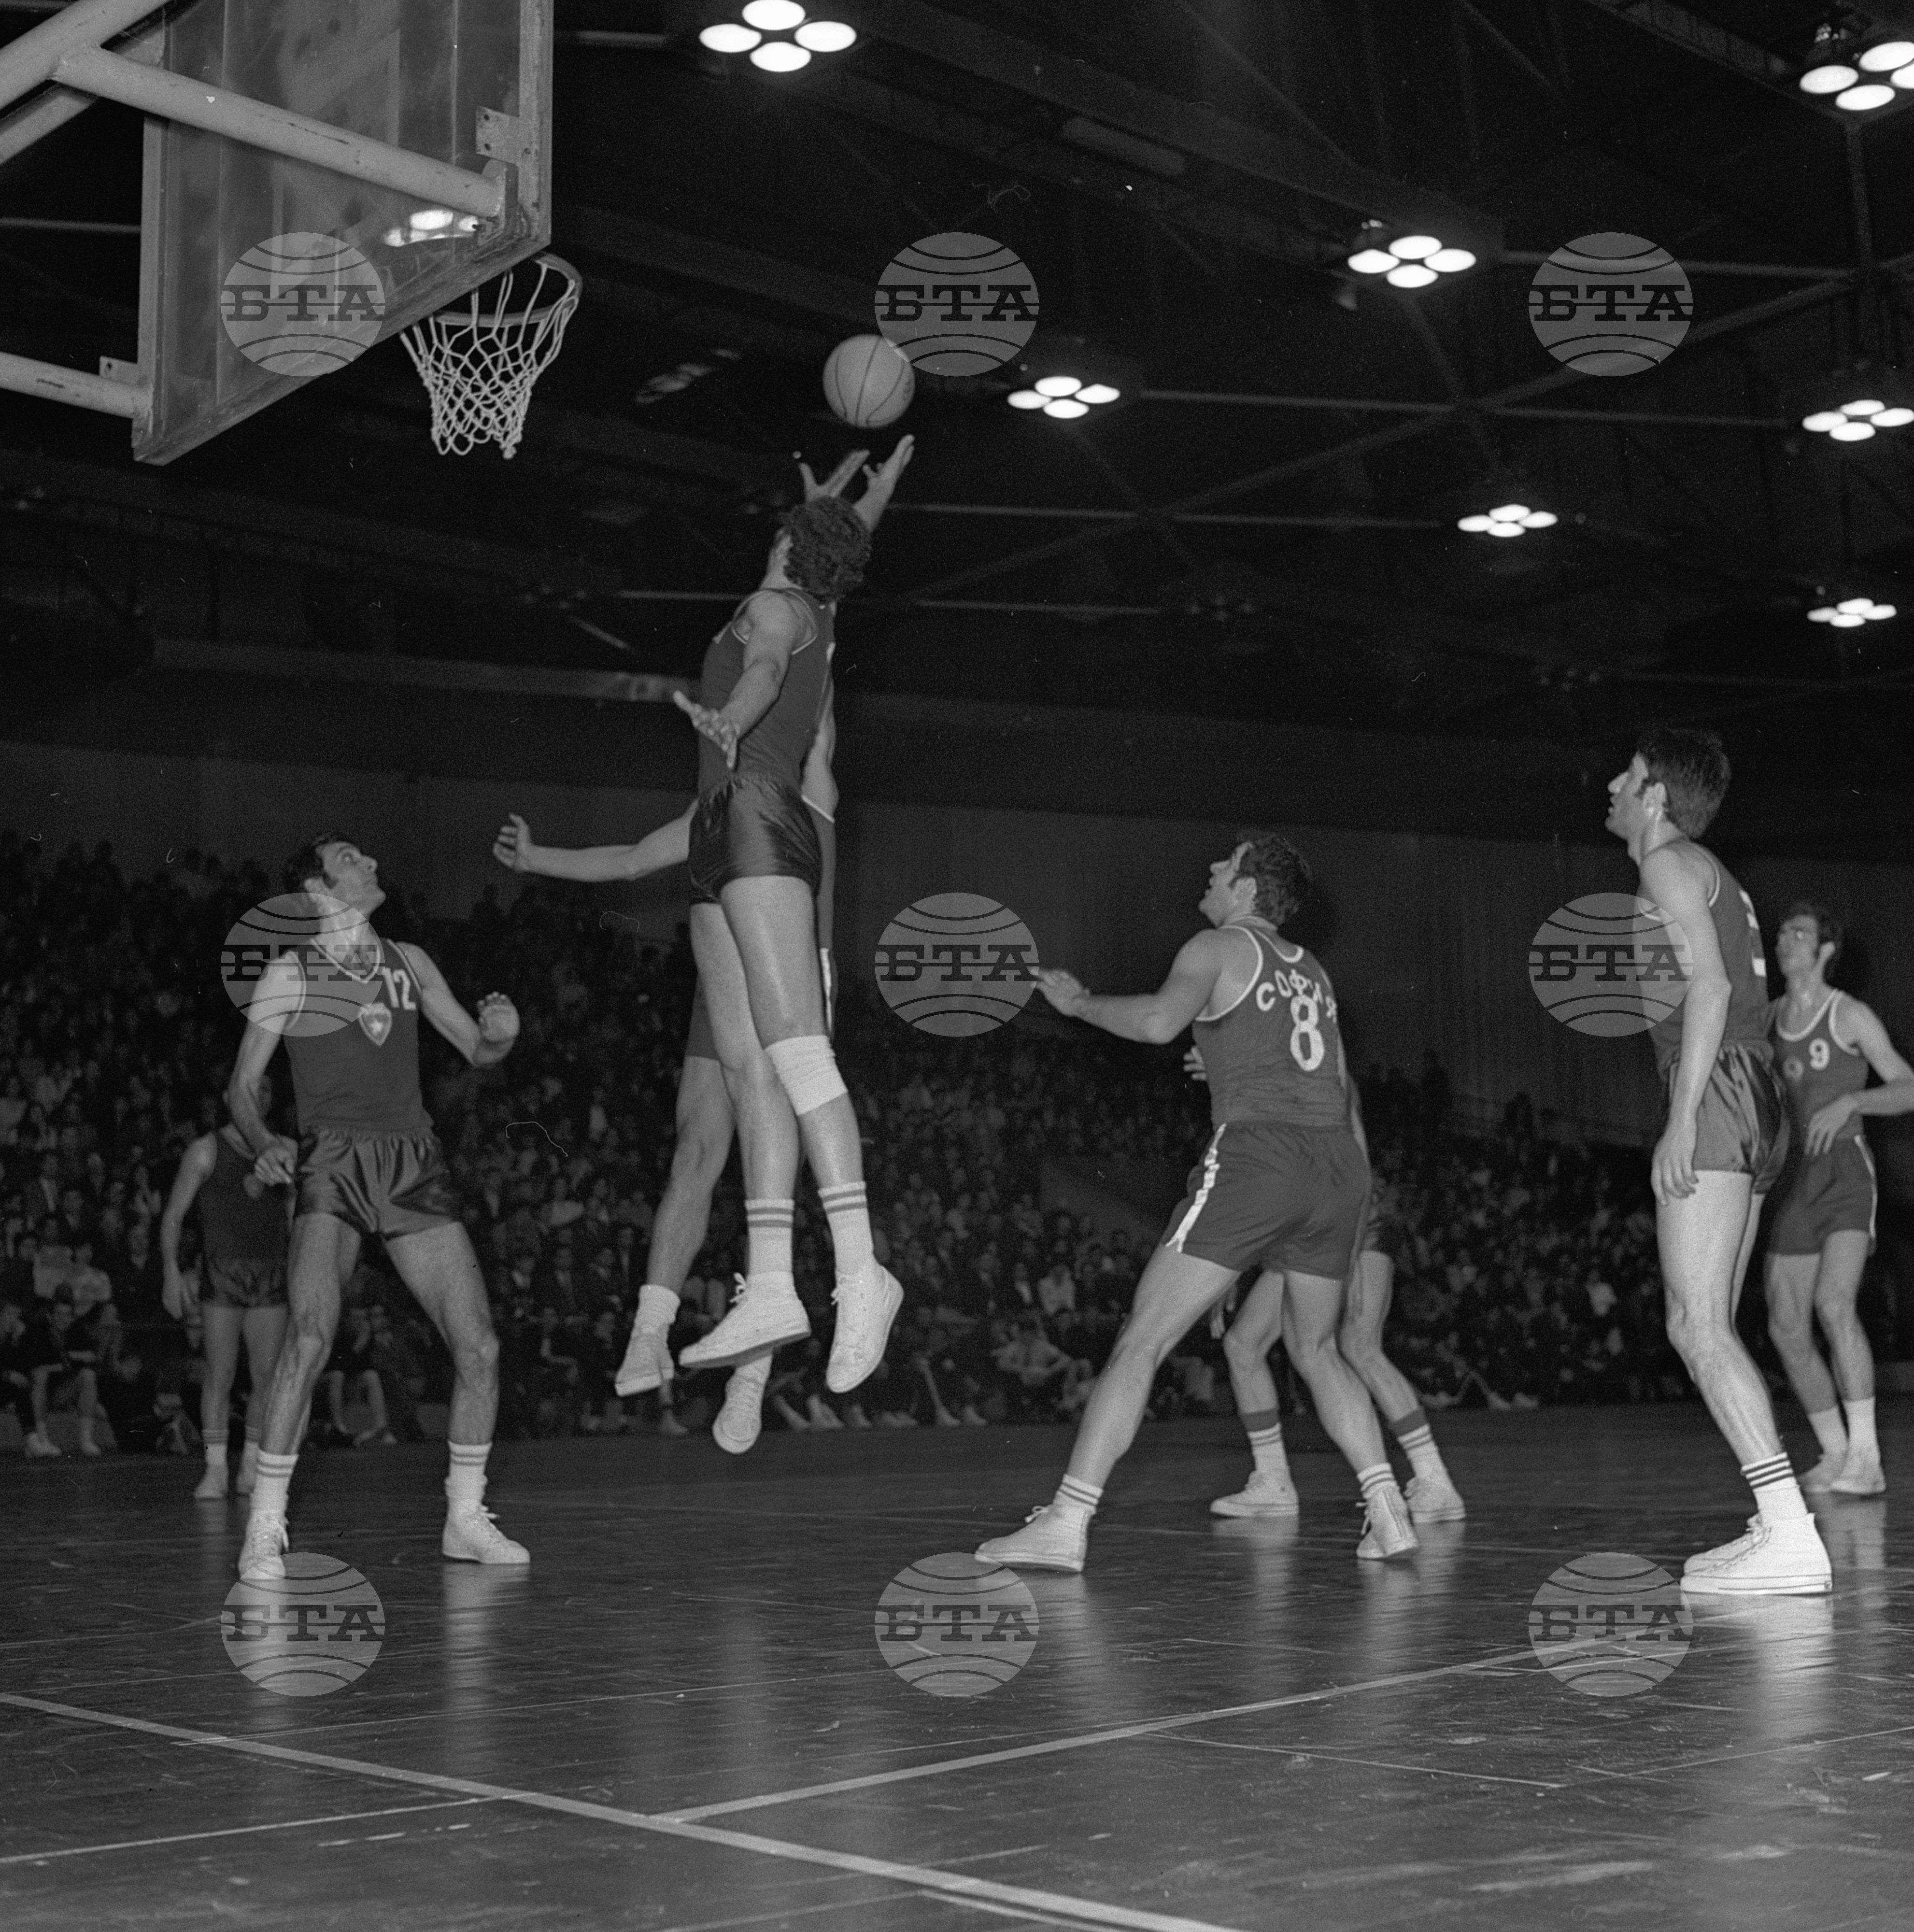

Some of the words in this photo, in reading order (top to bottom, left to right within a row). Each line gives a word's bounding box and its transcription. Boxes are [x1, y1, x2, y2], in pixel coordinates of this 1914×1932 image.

[382, 967, 417, 1011] 12
[1290, 994, 1325, 1072] 8
[1809, 1037, 1830, 1071] 9
